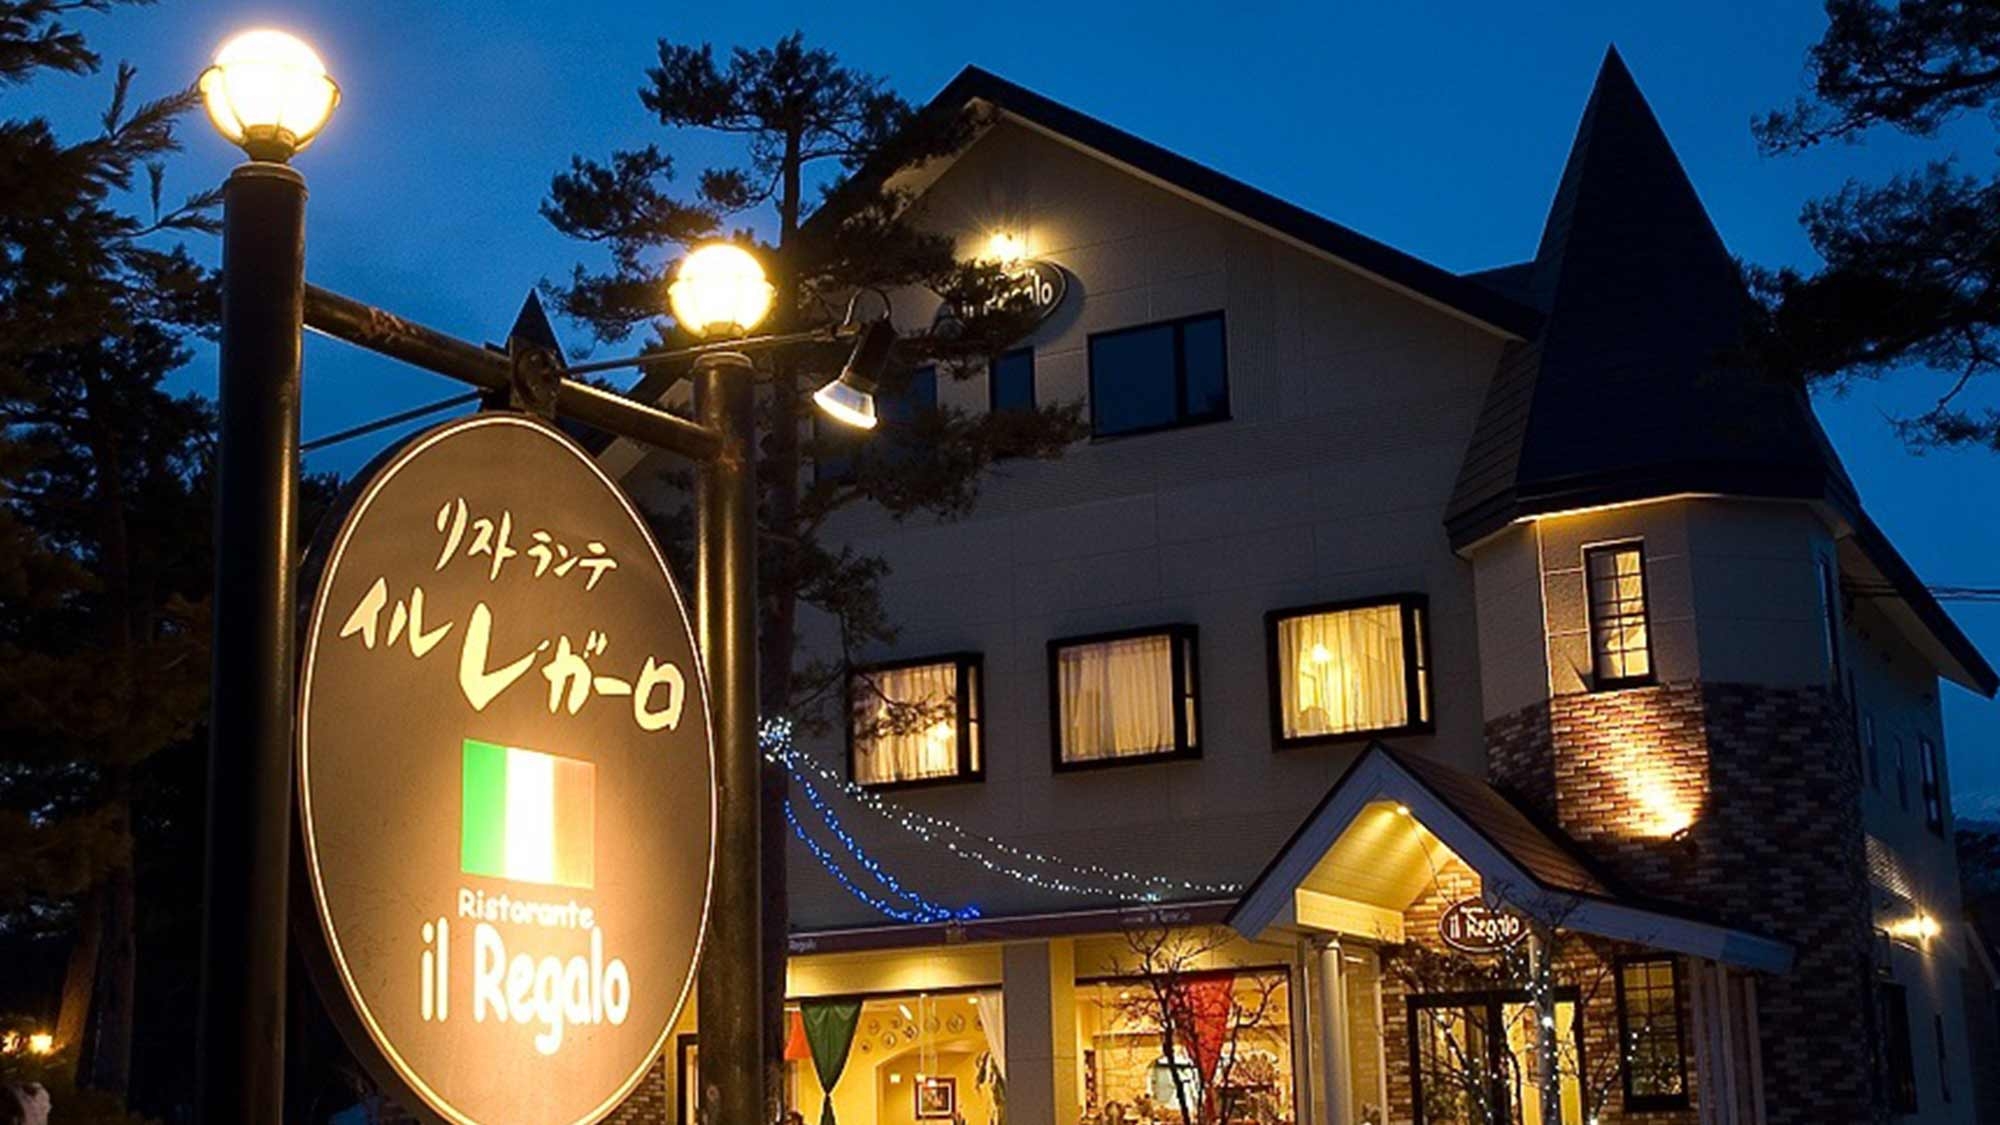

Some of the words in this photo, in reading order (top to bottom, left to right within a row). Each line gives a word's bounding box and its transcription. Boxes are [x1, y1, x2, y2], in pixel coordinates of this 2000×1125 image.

[435, 497, 618, 591] リストランテ
[458, 887, 595, 930] Ristorante
[421, 916, 449, 1022] il
[473, 922, 631, 1055] Regalo
